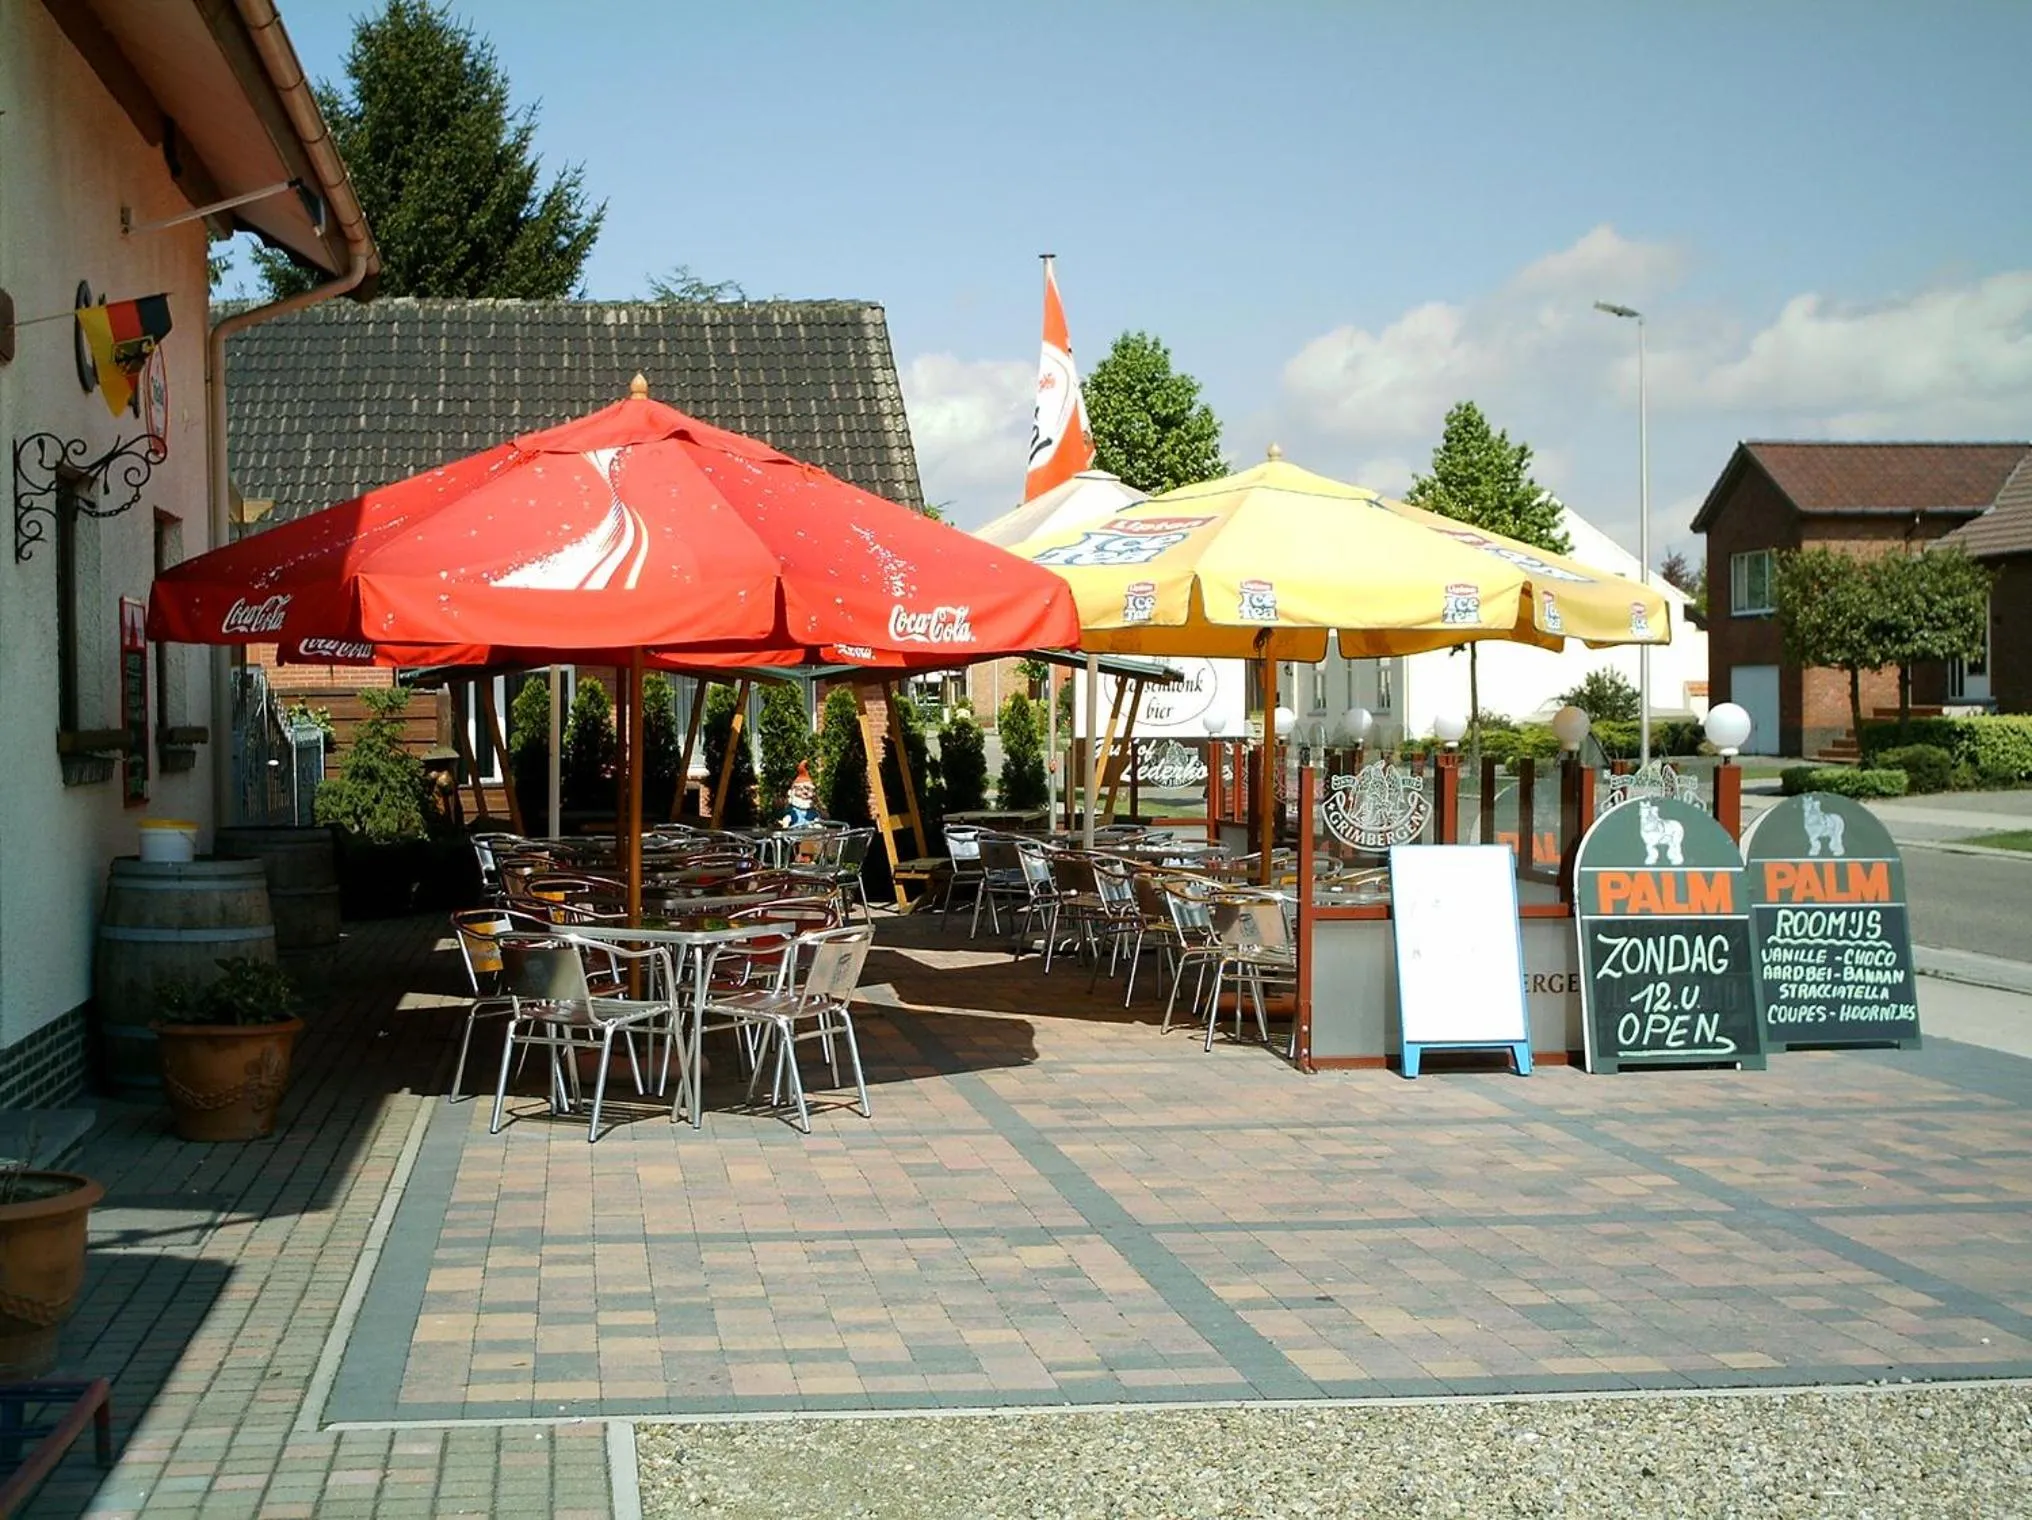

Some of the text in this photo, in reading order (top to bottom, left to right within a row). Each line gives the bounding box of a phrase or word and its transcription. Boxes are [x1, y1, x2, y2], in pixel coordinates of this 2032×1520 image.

[888, 604, 976, 644] Coca-Cola
[1328, 810, 1426, 847] GRIMBERGEN
[1597, 871, 1734, 914] PALM
[1763, 861, 1892, 903] PALM
[1596, 933, 1730, 979] ZONDAG
[1761, 947, 1827, 963] VANILLE
[1779, 983, 1890, 999] STRACCIATELLA
[1618, 1012, 1720, 1048] OPEN
[1767, 1004, 1827, 1024] COUPES
